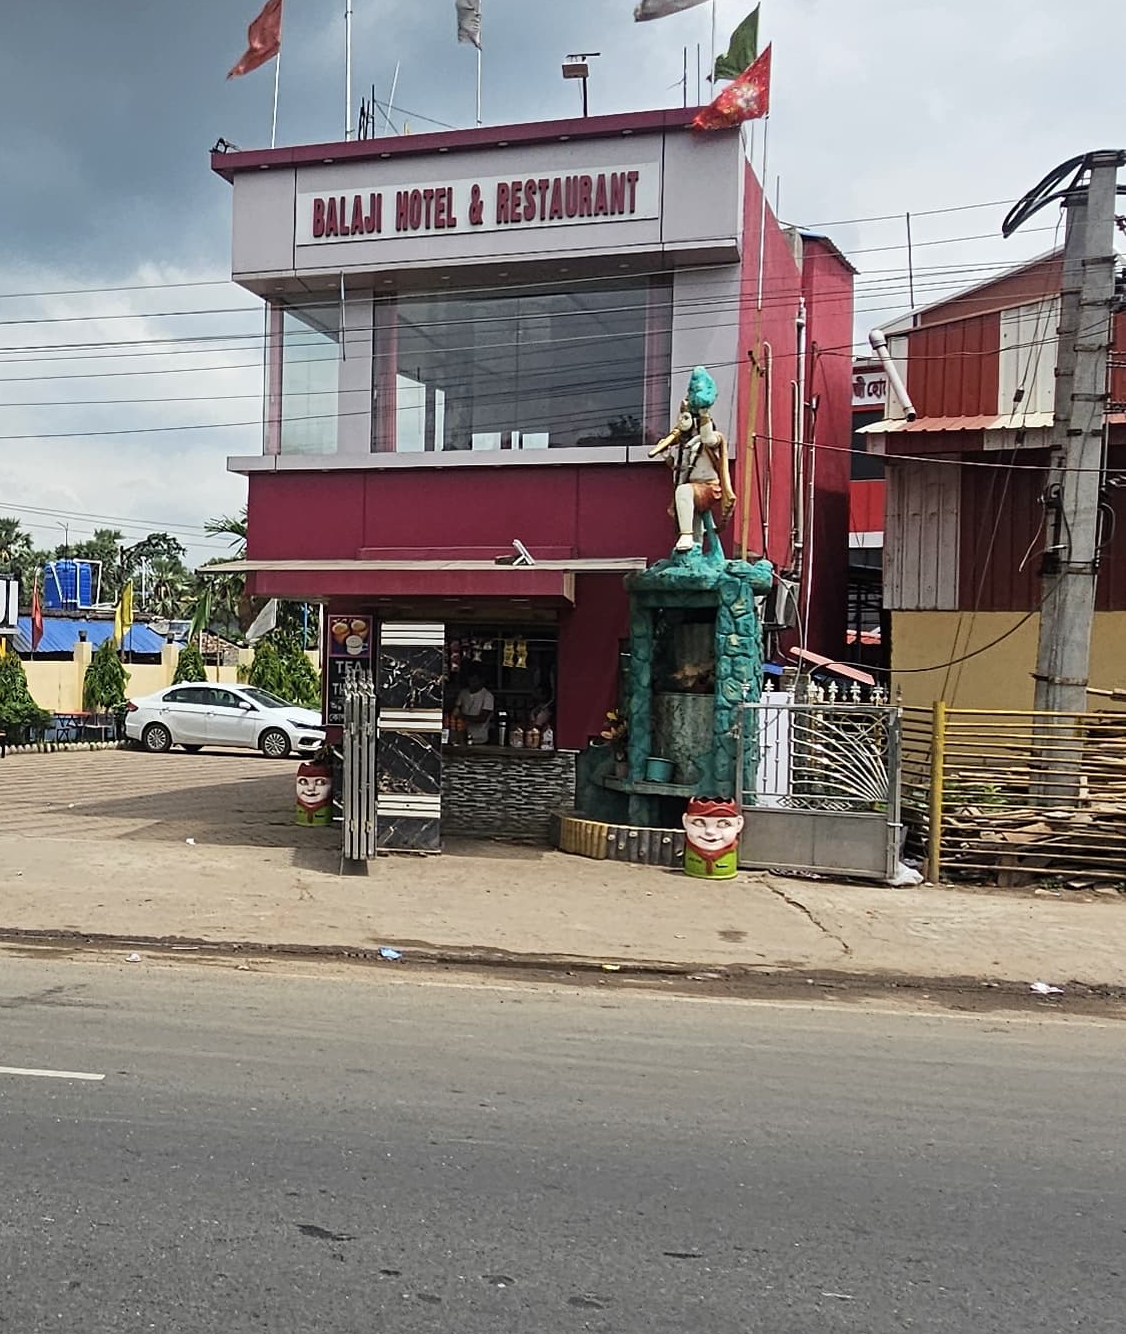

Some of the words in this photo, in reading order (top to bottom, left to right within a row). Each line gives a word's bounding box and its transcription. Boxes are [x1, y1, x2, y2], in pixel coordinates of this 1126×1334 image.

[312, 193, 383, 238] BALAJI
[395, 187, 457, 232] HOTEL
[469, 184, 484, 226] &
[496, 170, 639, 224] RESTAURANT
